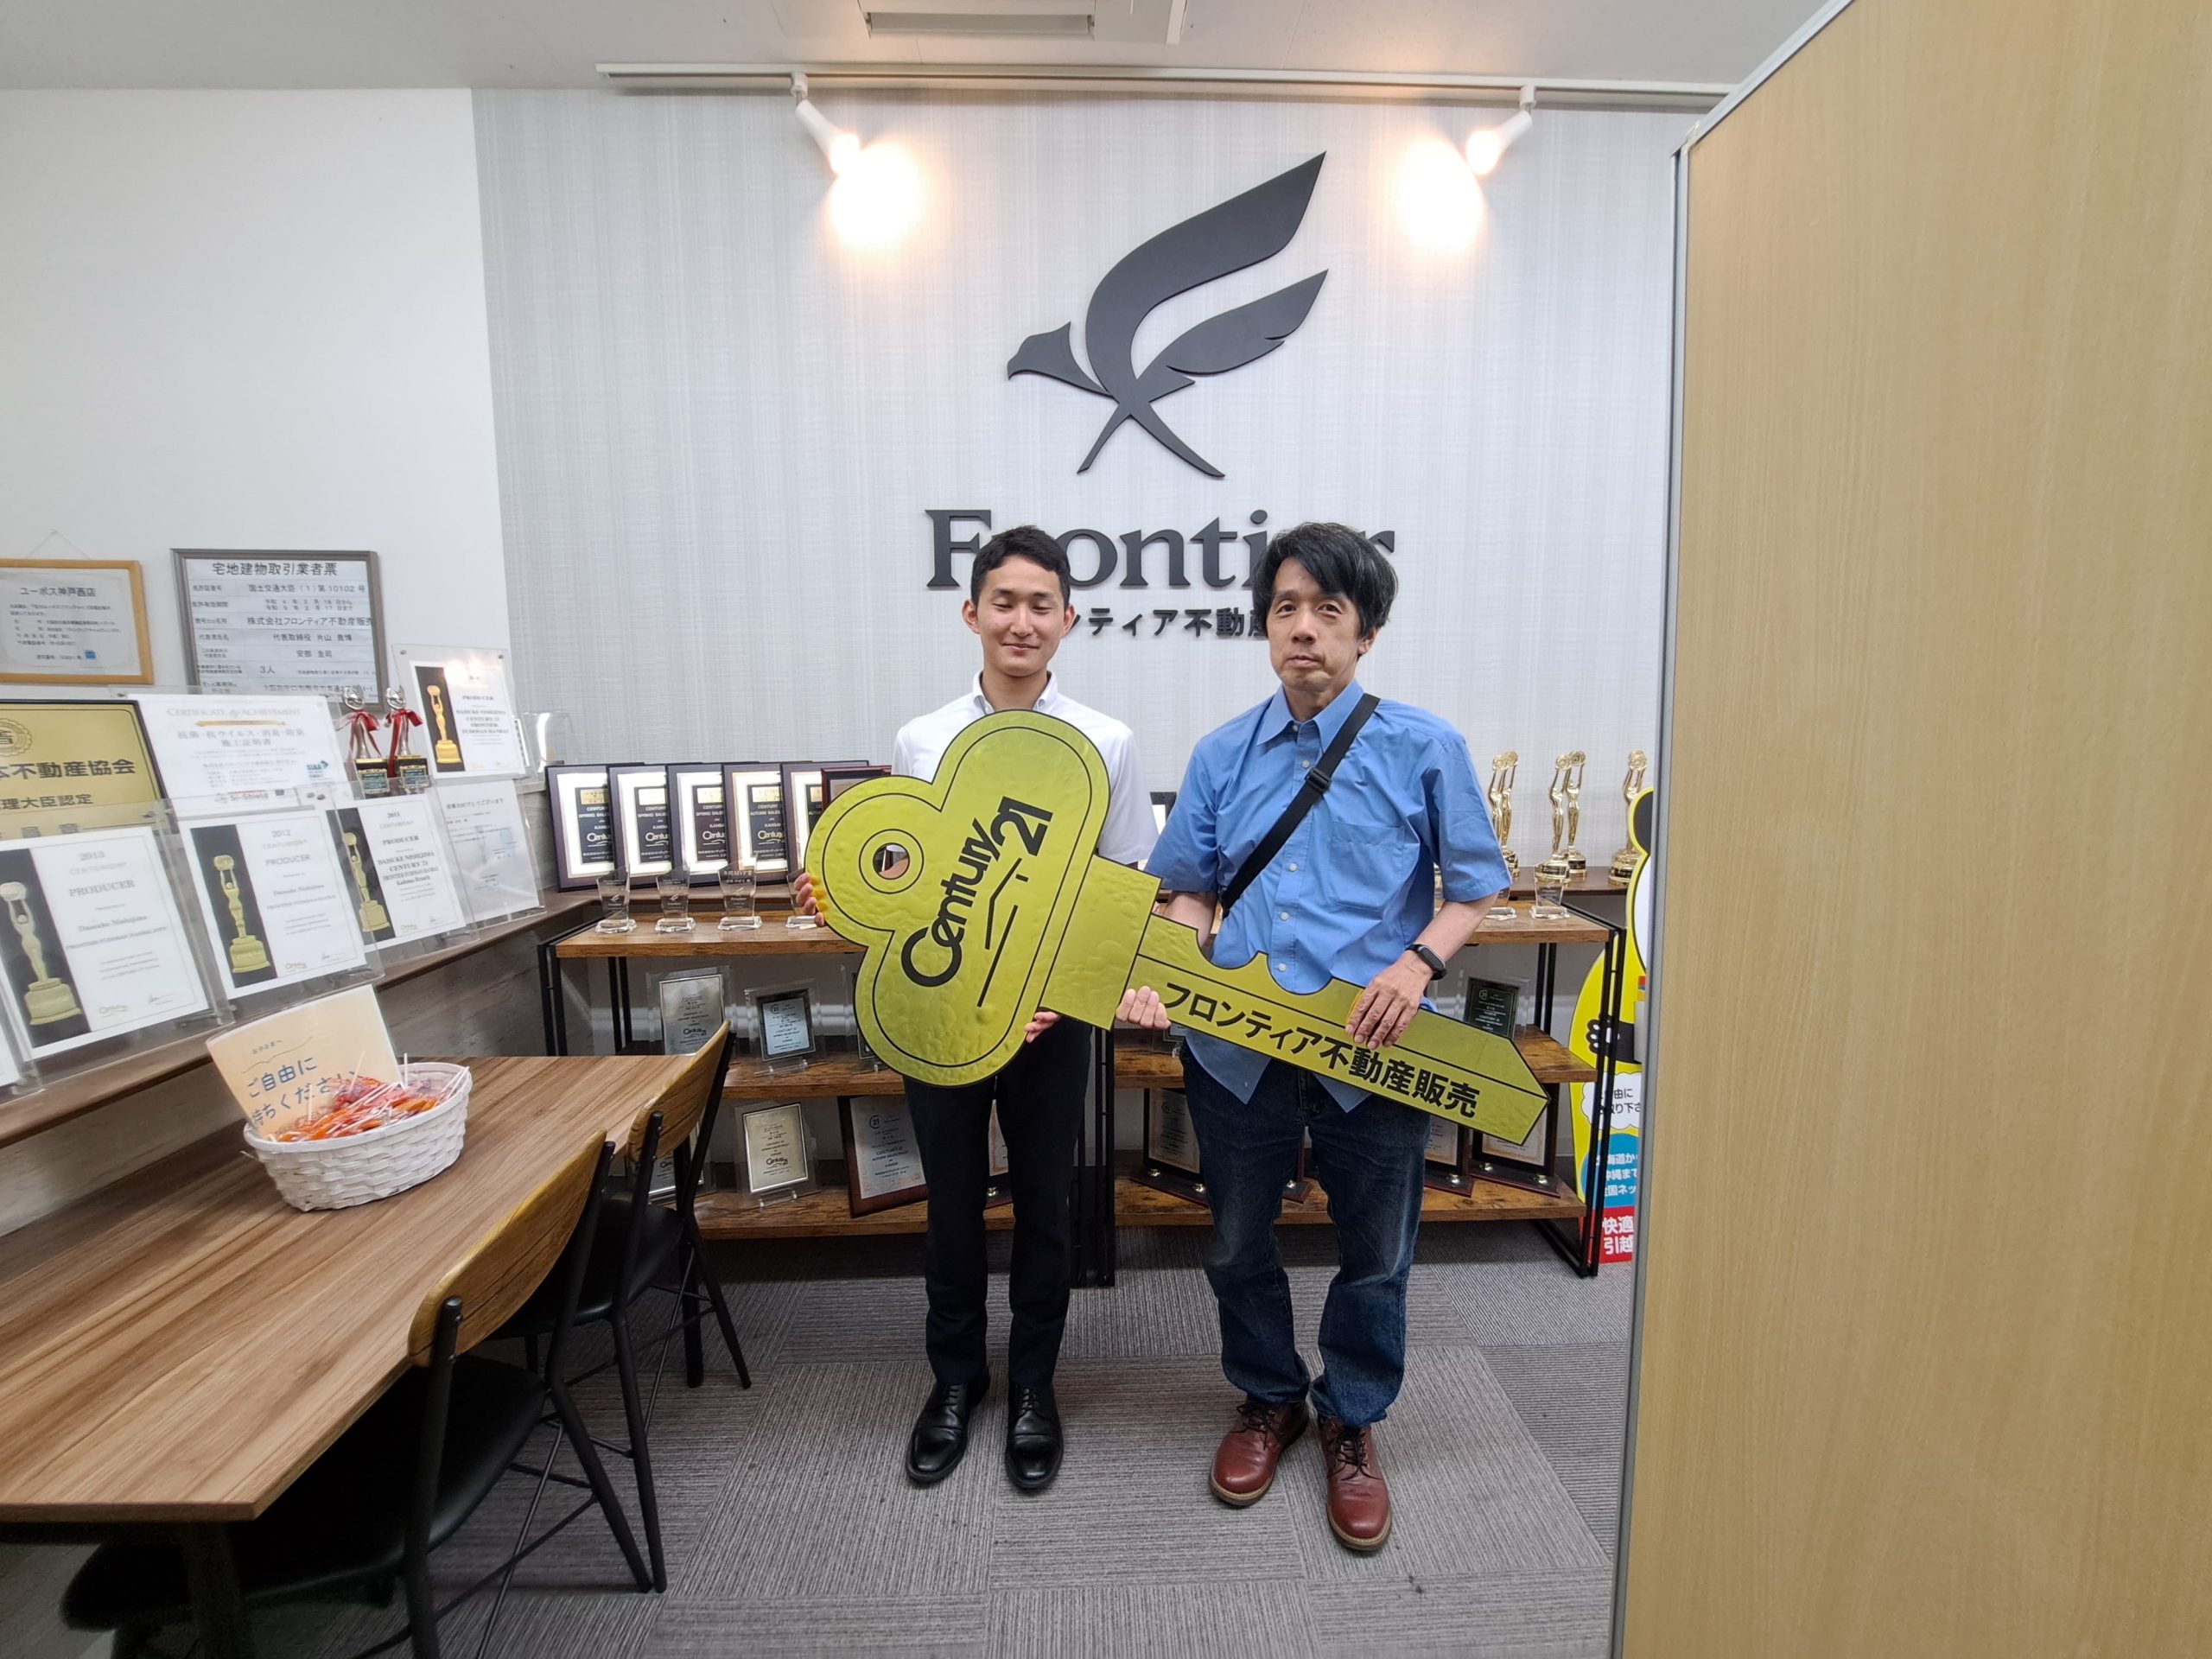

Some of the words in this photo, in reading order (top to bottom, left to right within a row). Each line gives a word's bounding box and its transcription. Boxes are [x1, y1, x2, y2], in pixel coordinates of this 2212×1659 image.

[213, 563, 338, 576] 宅地建物取引業者票
[382, 836, 419, 845] PRODUCER
[265, 855, 310, 866] PRODUCER
[69, 880, 135, 897] PRODUCER
[1166, 982, 1481, 1119] フロンティア不動産販売
[247, 1058, 318, 1097] ご自由に
[1602, 1215, 1634, 1236] 快適
[1604, 1235, 1634, 1255] 引越
